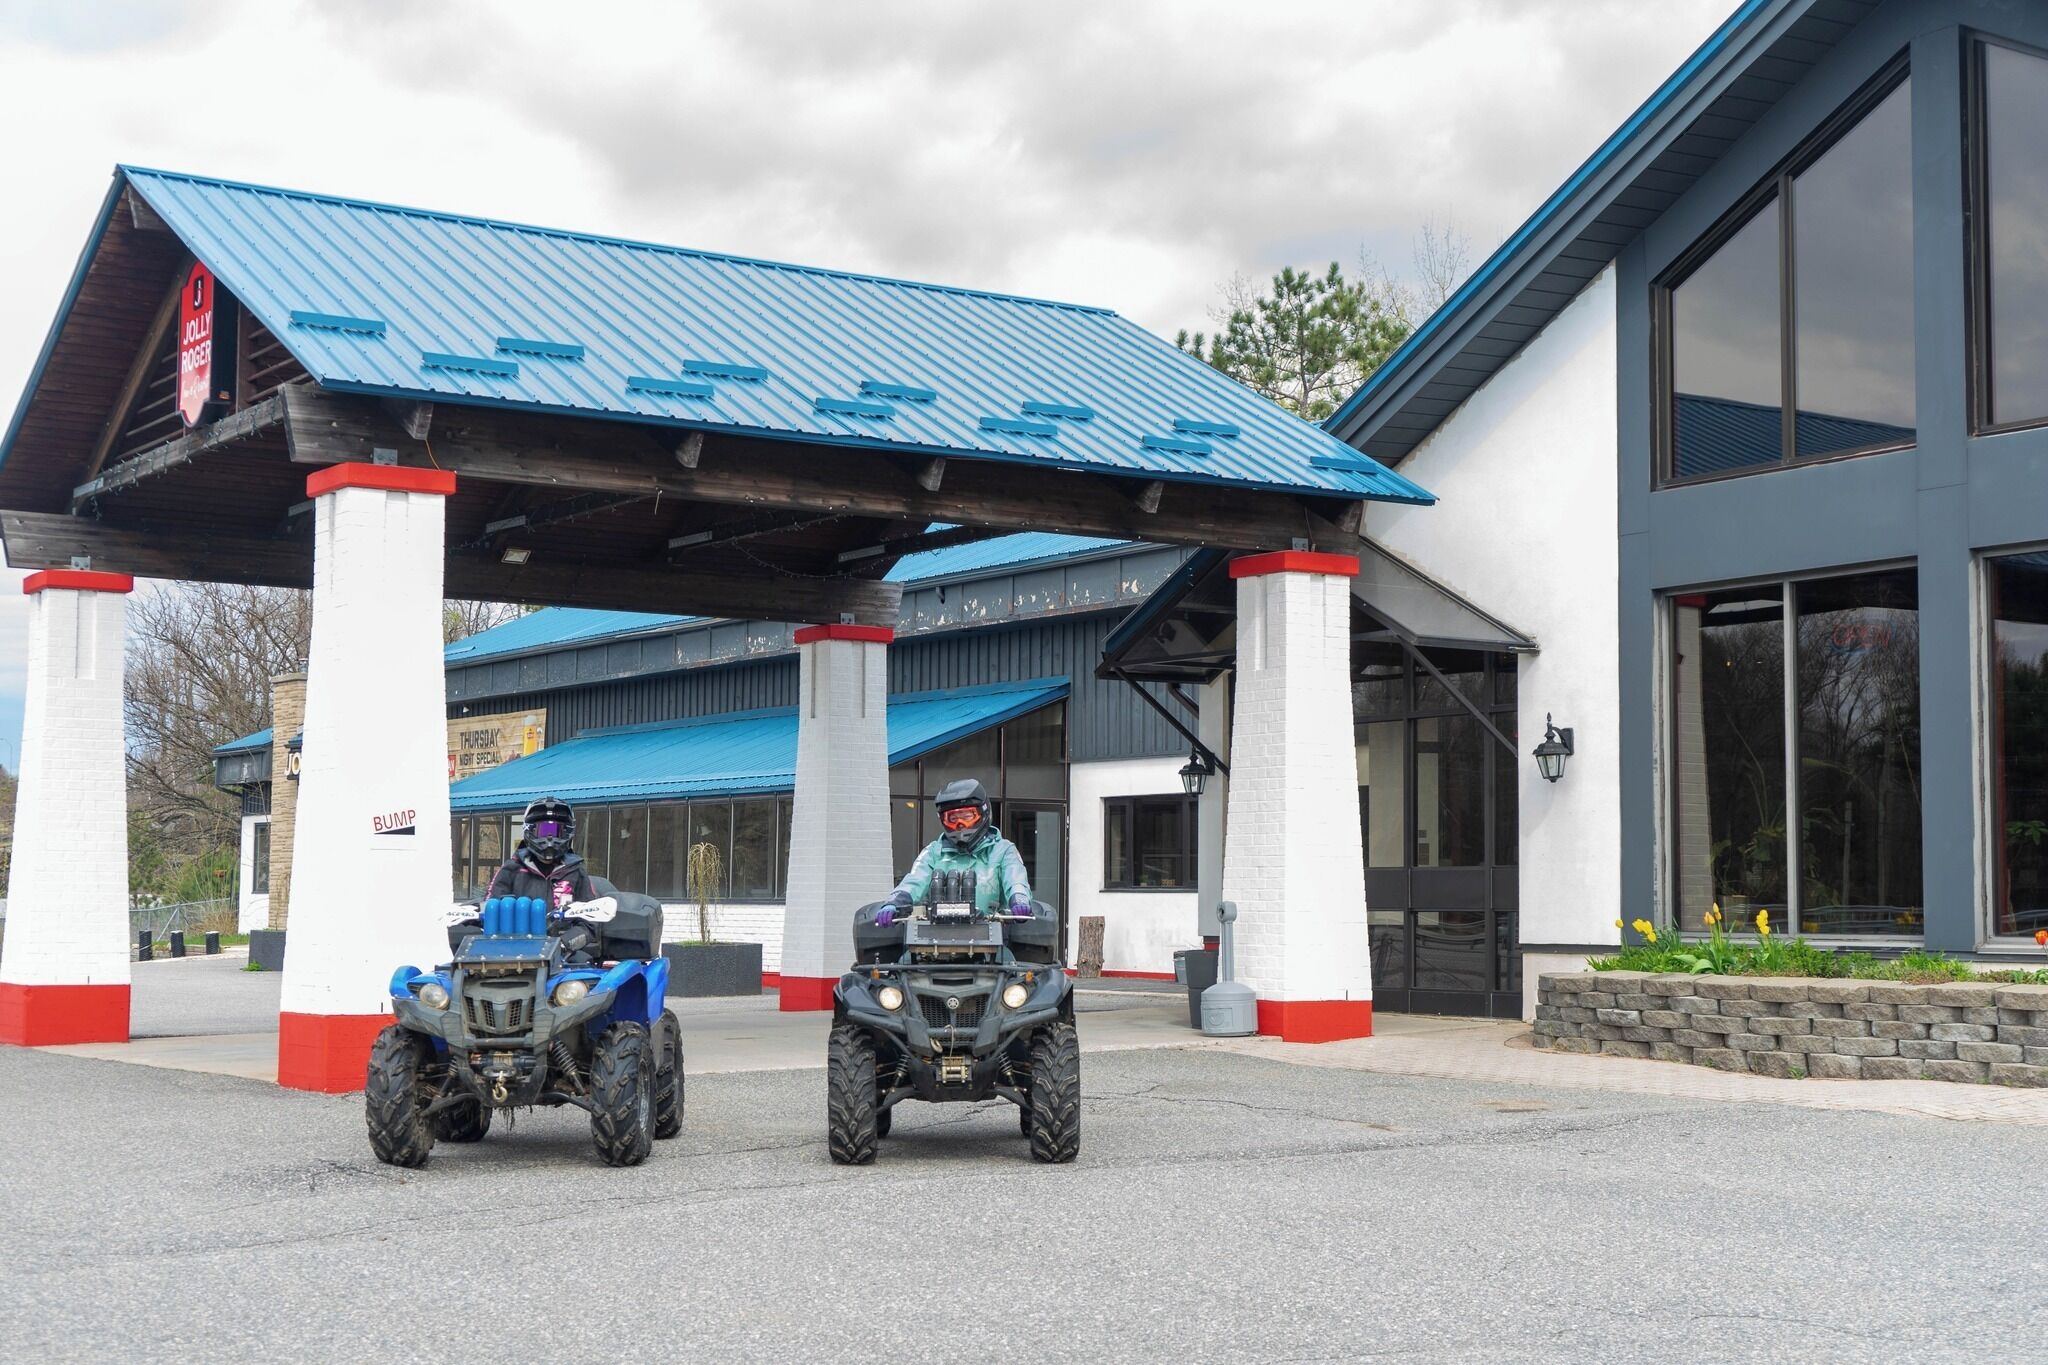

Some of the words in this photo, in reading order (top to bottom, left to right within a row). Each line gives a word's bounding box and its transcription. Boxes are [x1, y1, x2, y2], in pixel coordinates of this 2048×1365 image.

[183, 310, 212, 345] JOLLY
[181, 340, 211, 374] ROGER
[460, 728, 500, 750] THURSDAY
[284, 752, 301, 776] JO
[460, 753, 474, 766] NIGHT
[476, 751, 500, 765] SPECIAL
[373, 809, 416, 831] BUMP
